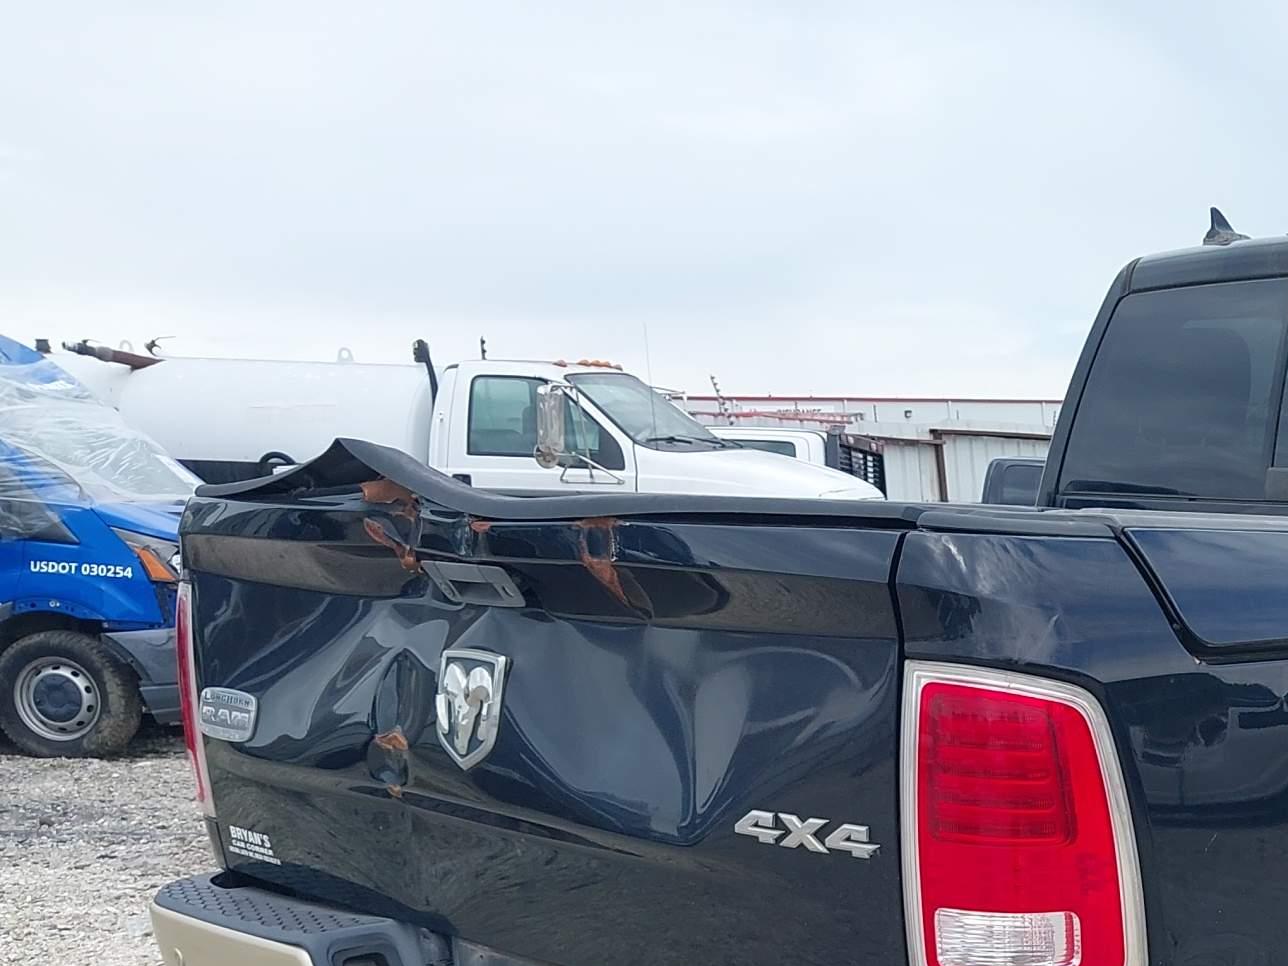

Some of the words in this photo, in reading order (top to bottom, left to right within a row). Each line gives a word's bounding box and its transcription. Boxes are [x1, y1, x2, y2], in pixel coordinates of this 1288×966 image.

[30, 561, 78, 574] USDOT
[81, 563, 133, 579] 030254
[229, 825, 271, 848] BRYAN'S
[734, 809, 881, 859] 4X4
